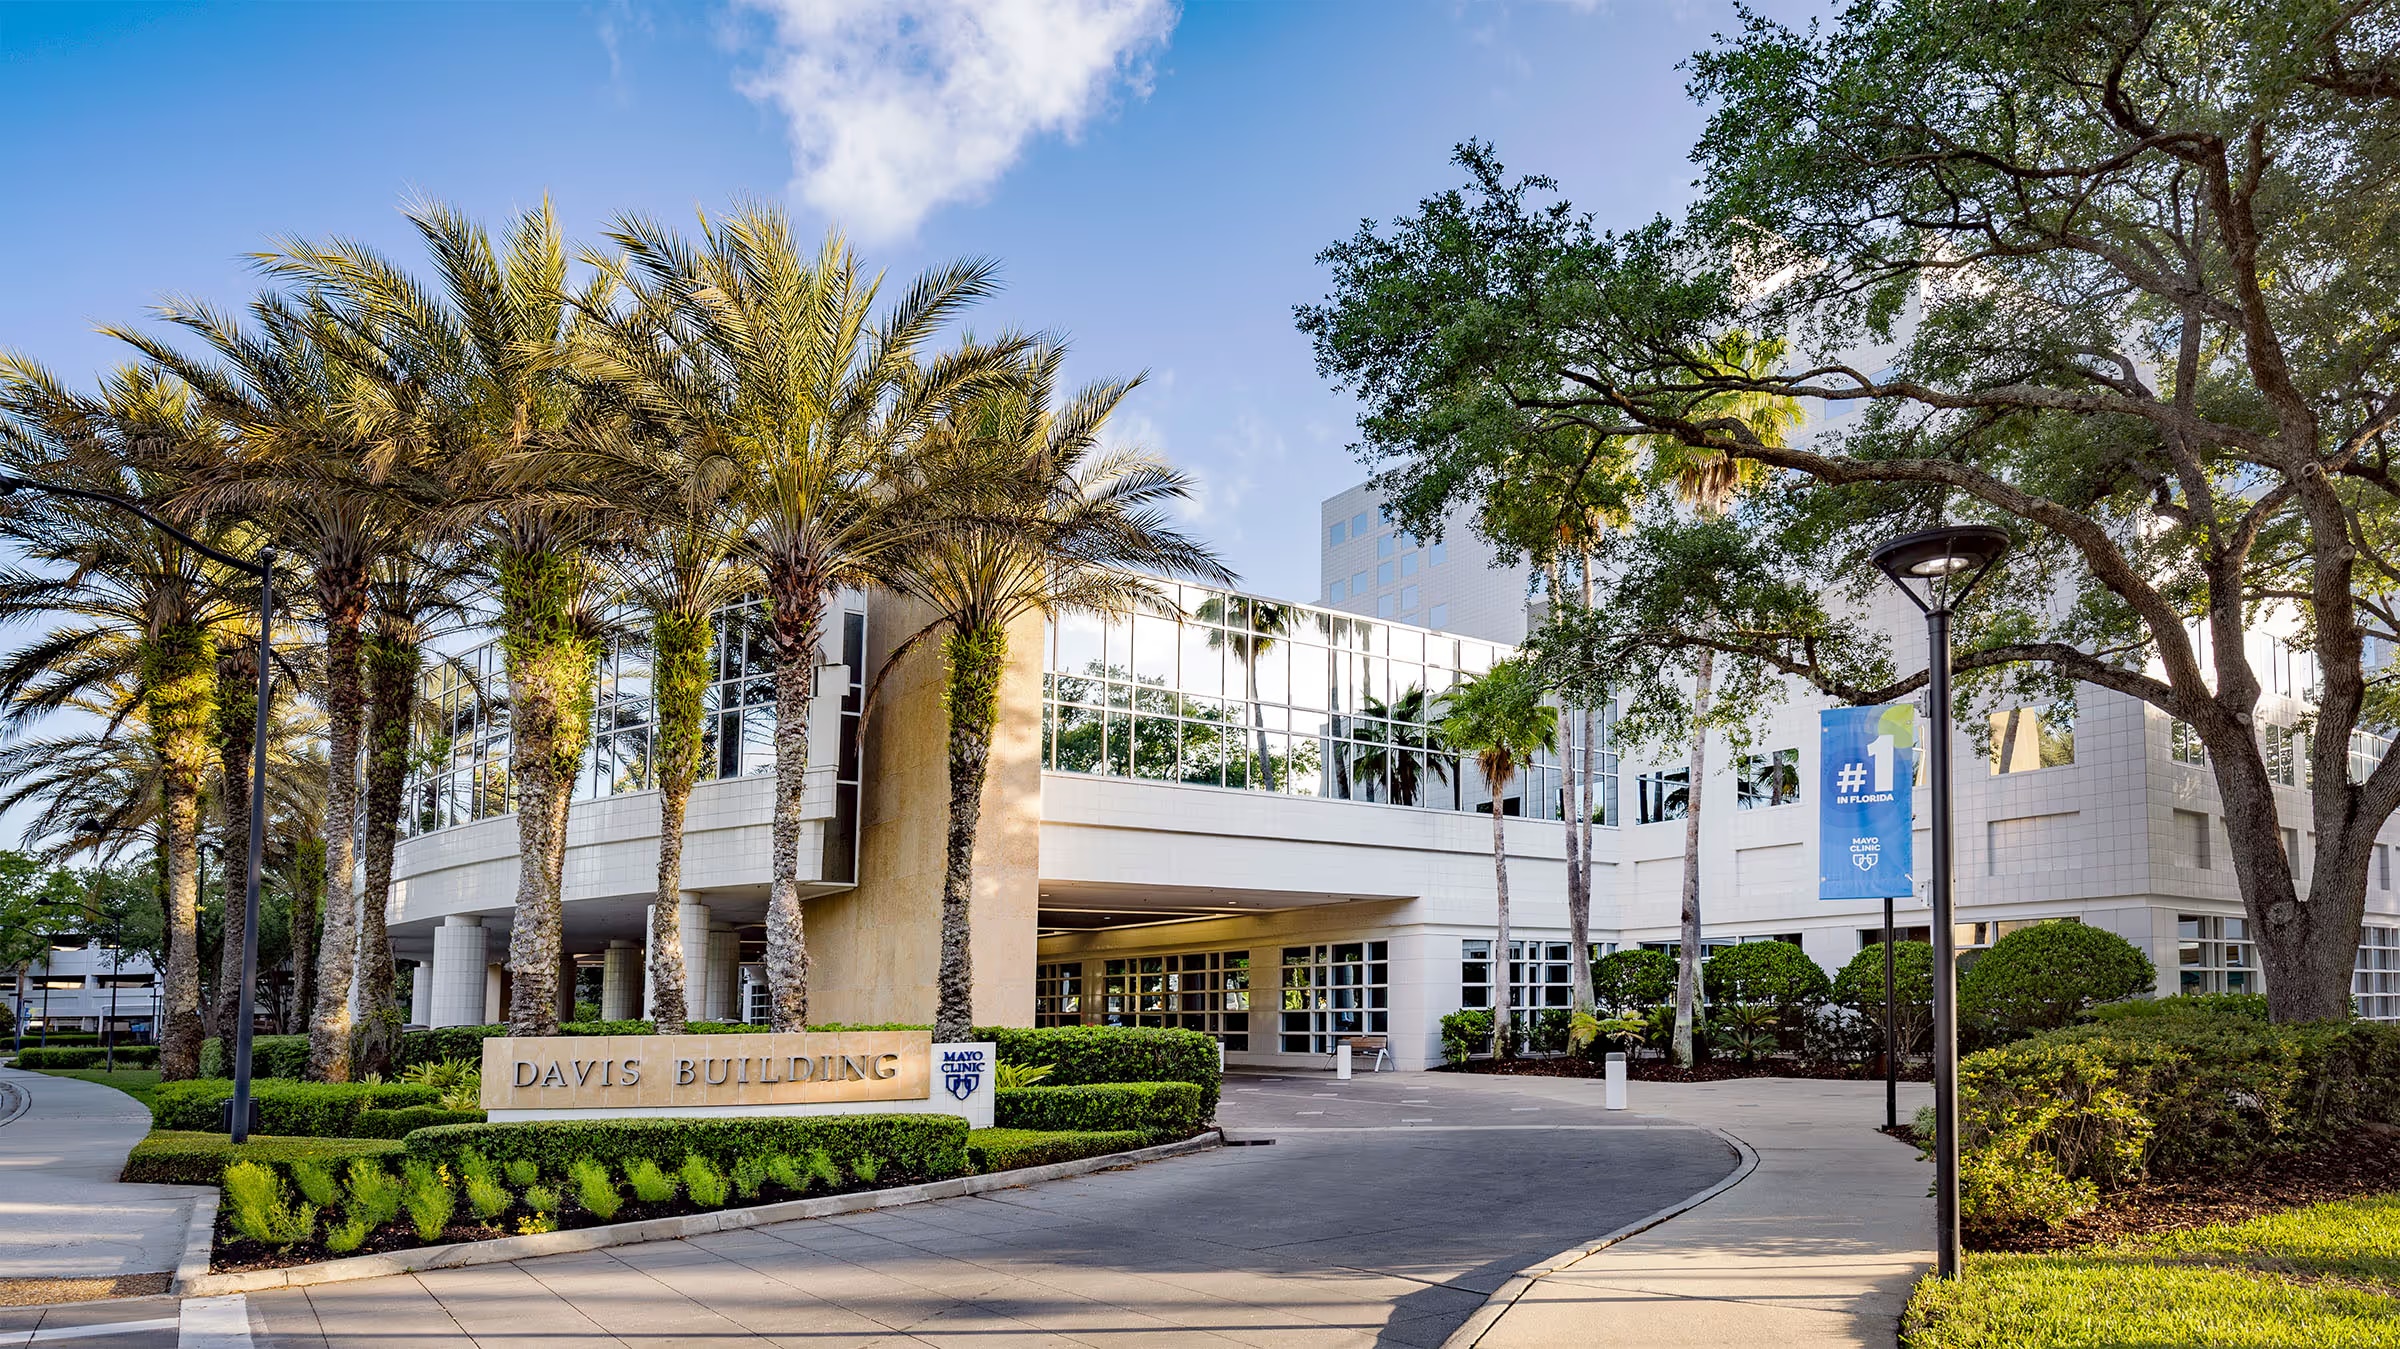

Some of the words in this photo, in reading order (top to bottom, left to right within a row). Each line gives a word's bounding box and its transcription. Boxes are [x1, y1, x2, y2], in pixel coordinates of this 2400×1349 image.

[1836, 734, 1894, 793] #1
[1837, 796, 1848, 804] IN
[1850, 793, 1894, 803] FLORIDA
[1852, 837, 1879, 845] MAYO
[1850, 844, 1881, 852] CLINIC
[943, 1051, 983, 1062] MAYO
[512, 1058, 641, 1088] DAVIS
[674, 1053, 900, 1085] BUILDING
[941, 1062, 985, 1073] CLINIC
